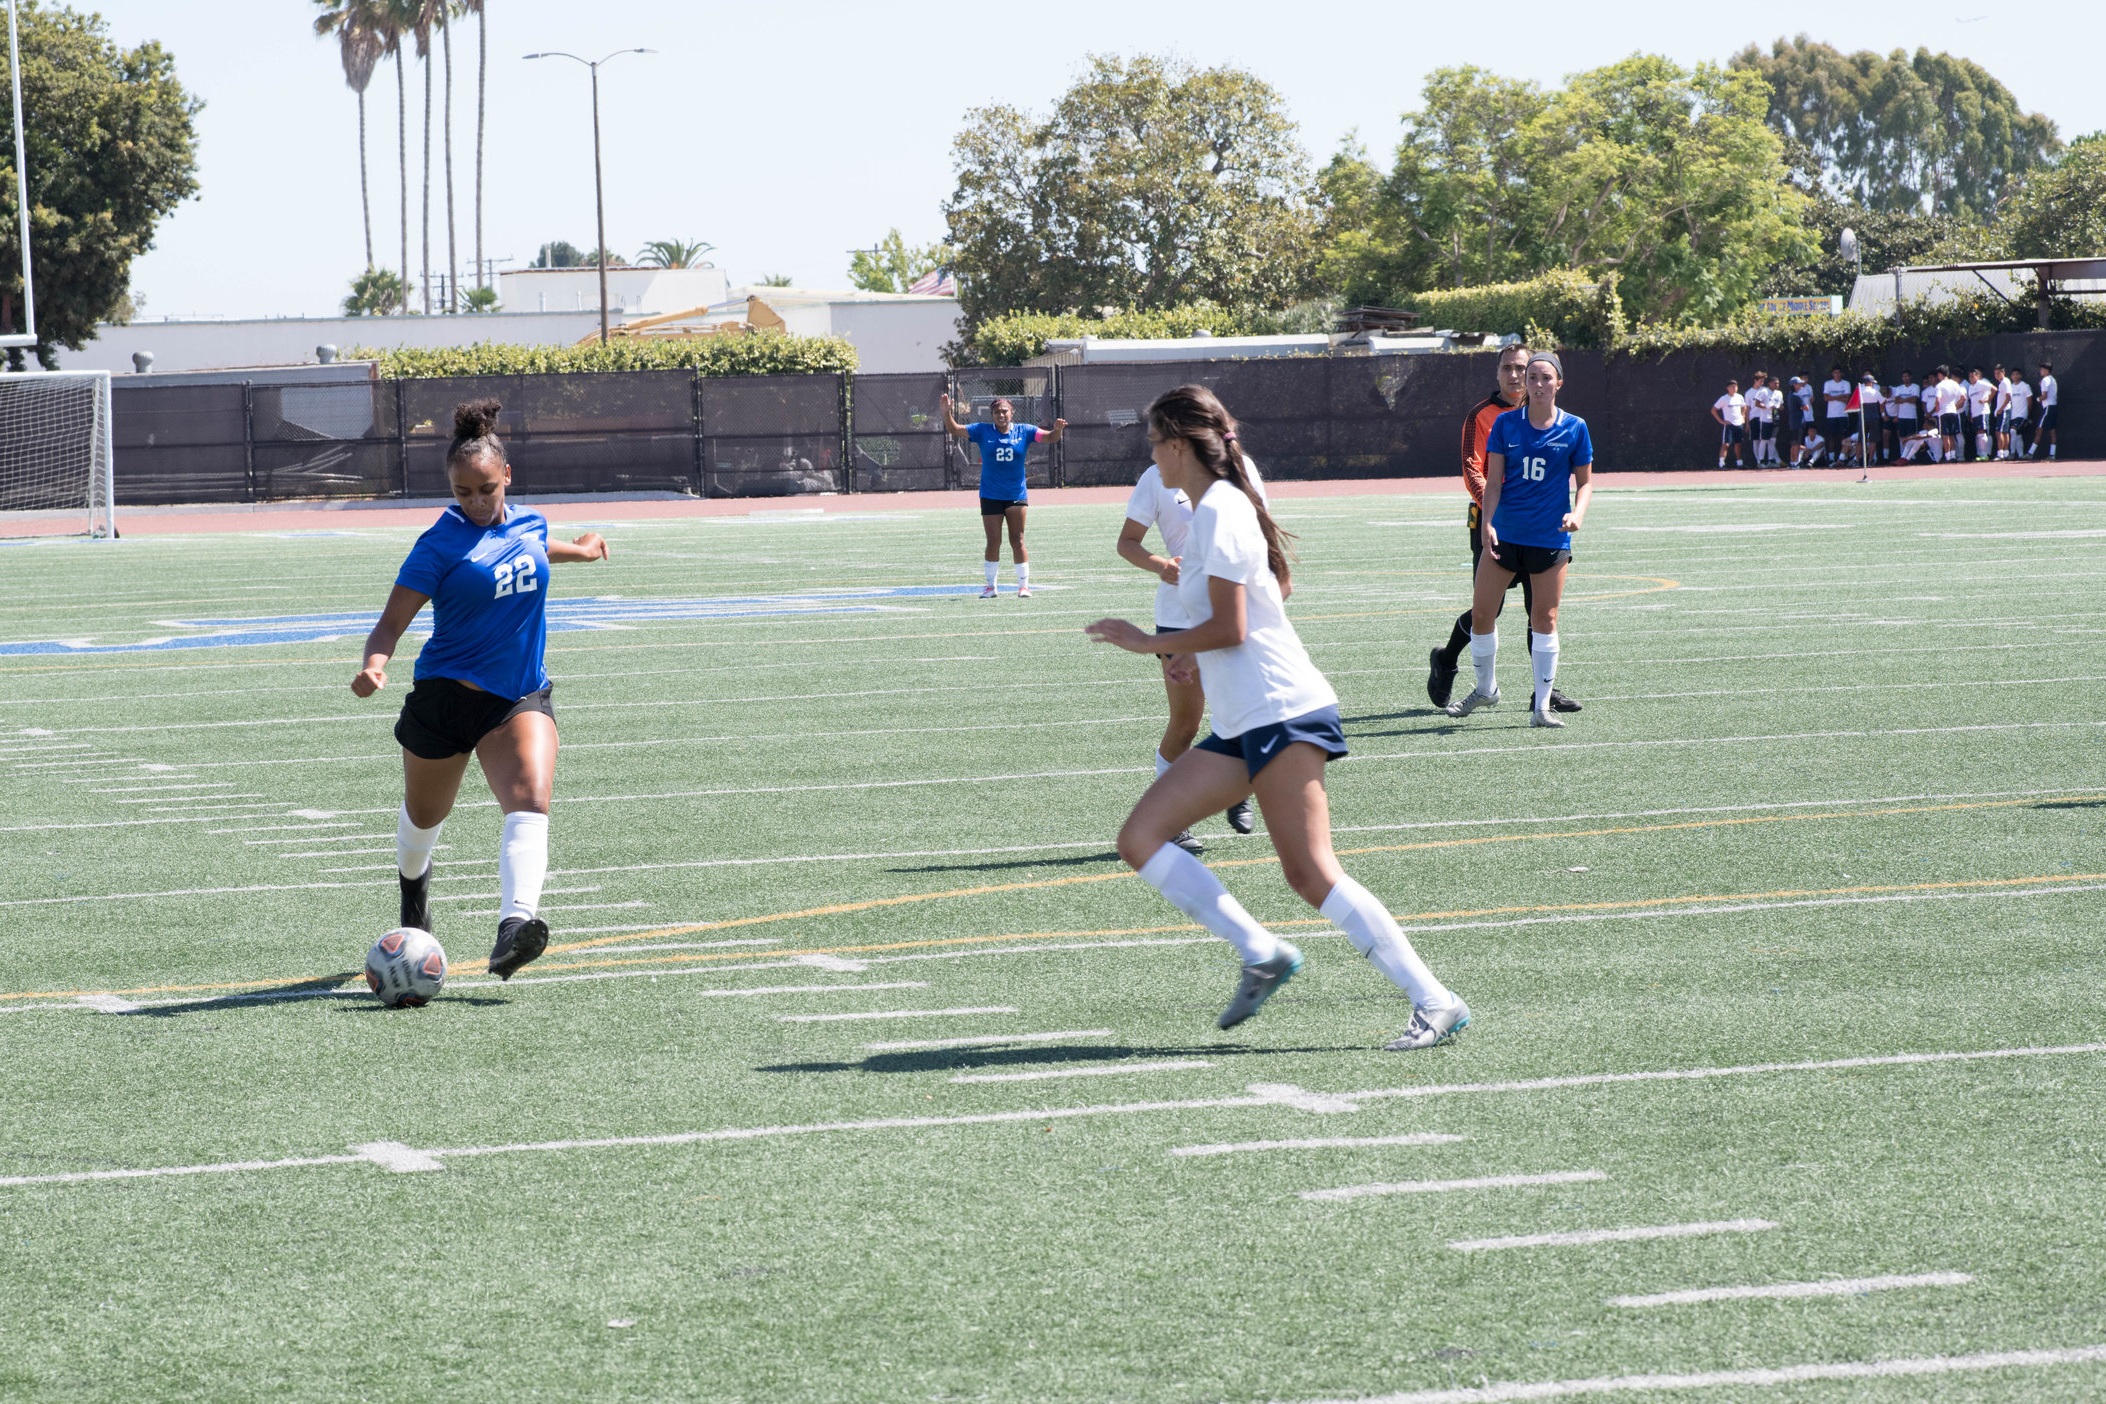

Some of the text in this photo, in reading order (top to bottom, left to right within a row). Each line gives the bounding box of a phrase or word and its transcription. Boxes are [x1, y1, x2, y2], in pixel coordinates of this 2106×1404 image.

[1809, 300, 1829, 311] SCOOL
[996, 447, 1014, 462] 23
[1522, 456, 1546, 482] 16
[494, 554, 537, 599] 22
